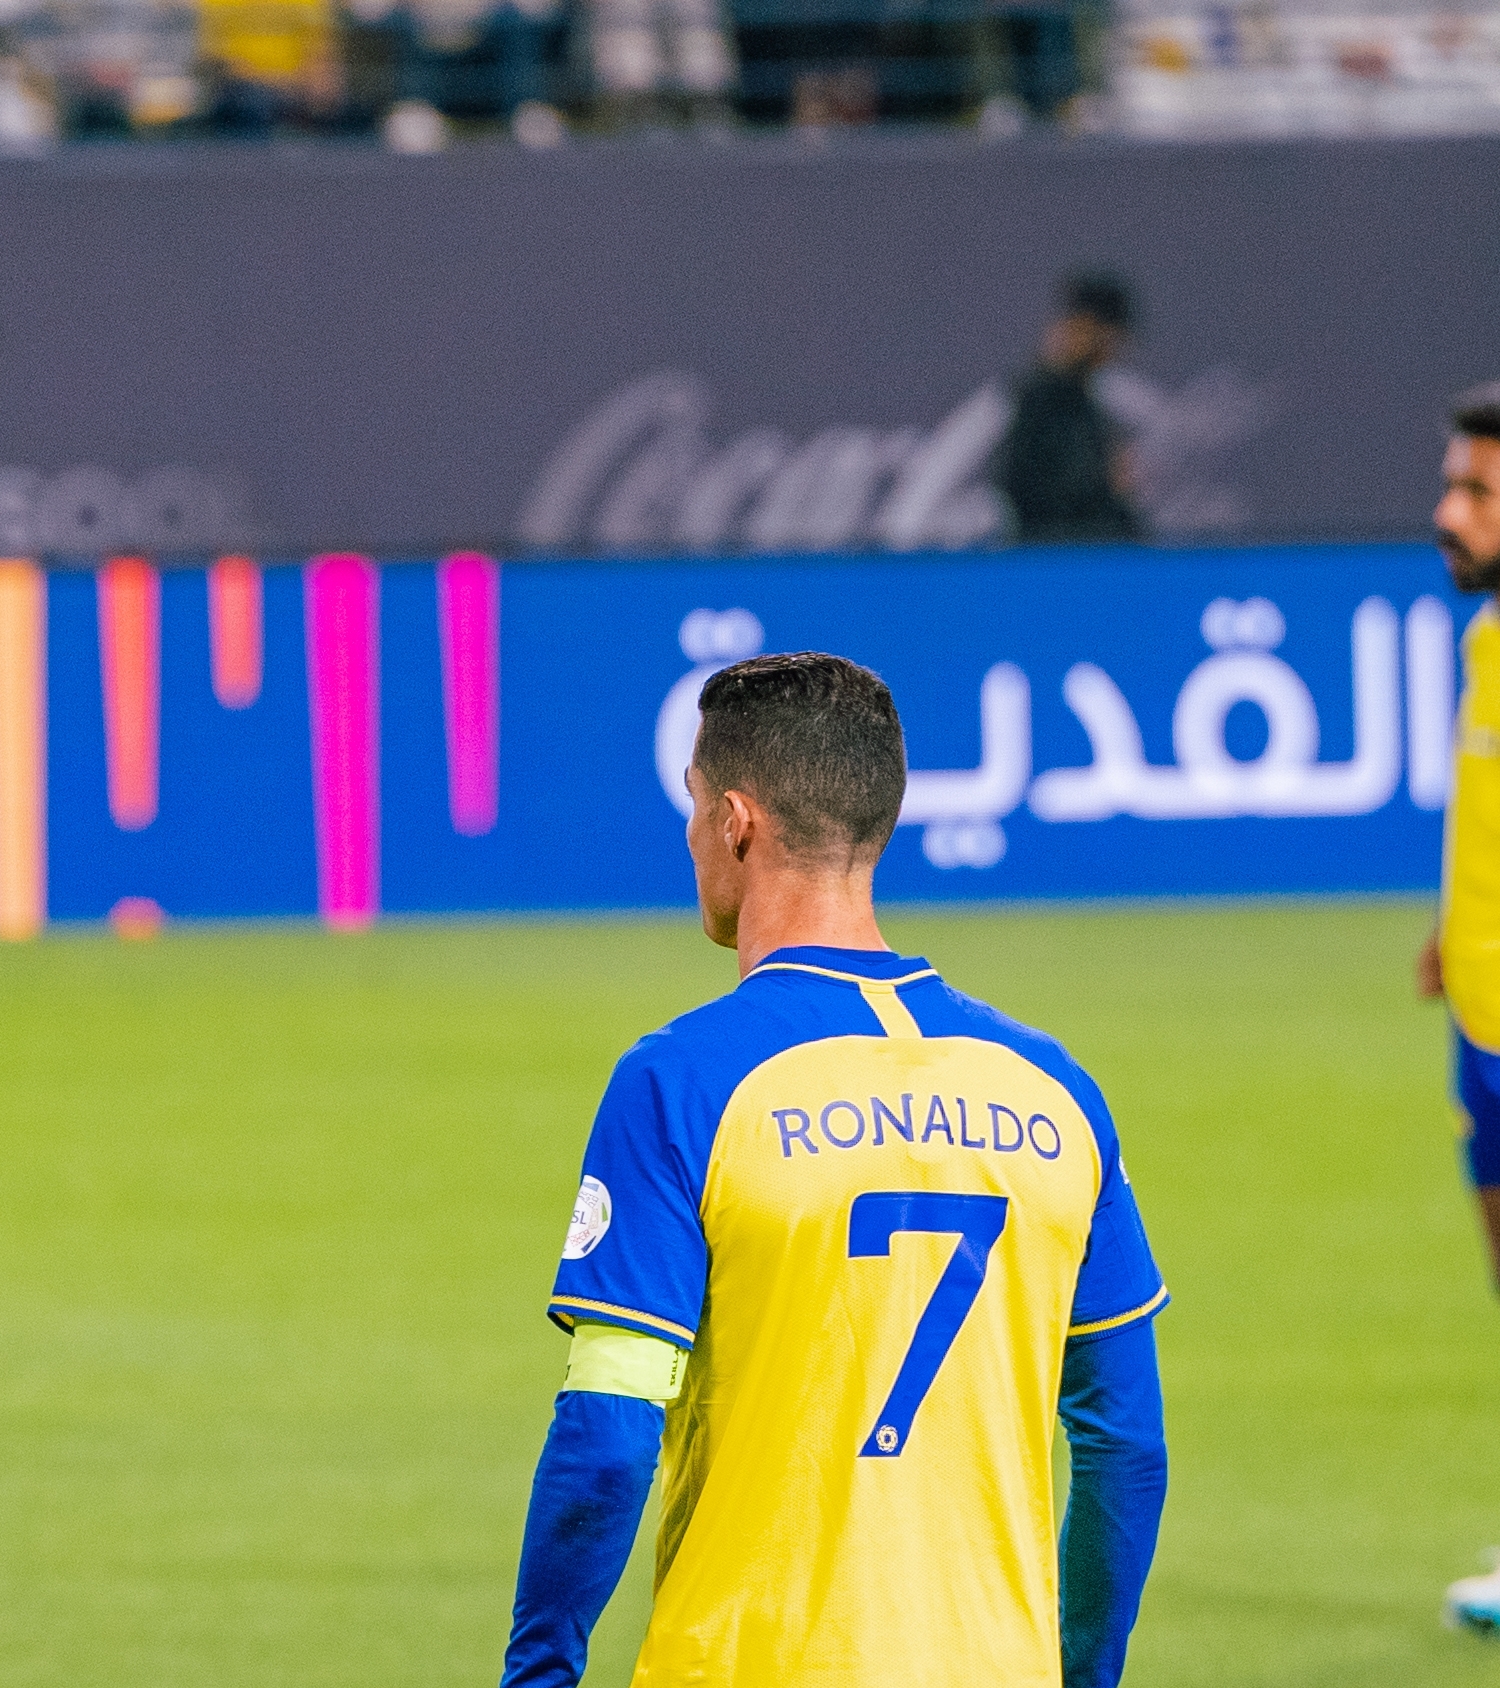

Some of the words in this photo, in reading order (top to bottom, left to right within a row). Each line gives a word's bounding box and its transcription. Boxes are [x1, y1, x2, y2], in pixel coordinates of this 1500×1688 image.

[771, 1093, 1062, 1160] RONALDO
[569, 1209, 588, 1225] SL
[847, 1190, 1009, 1458] 7
